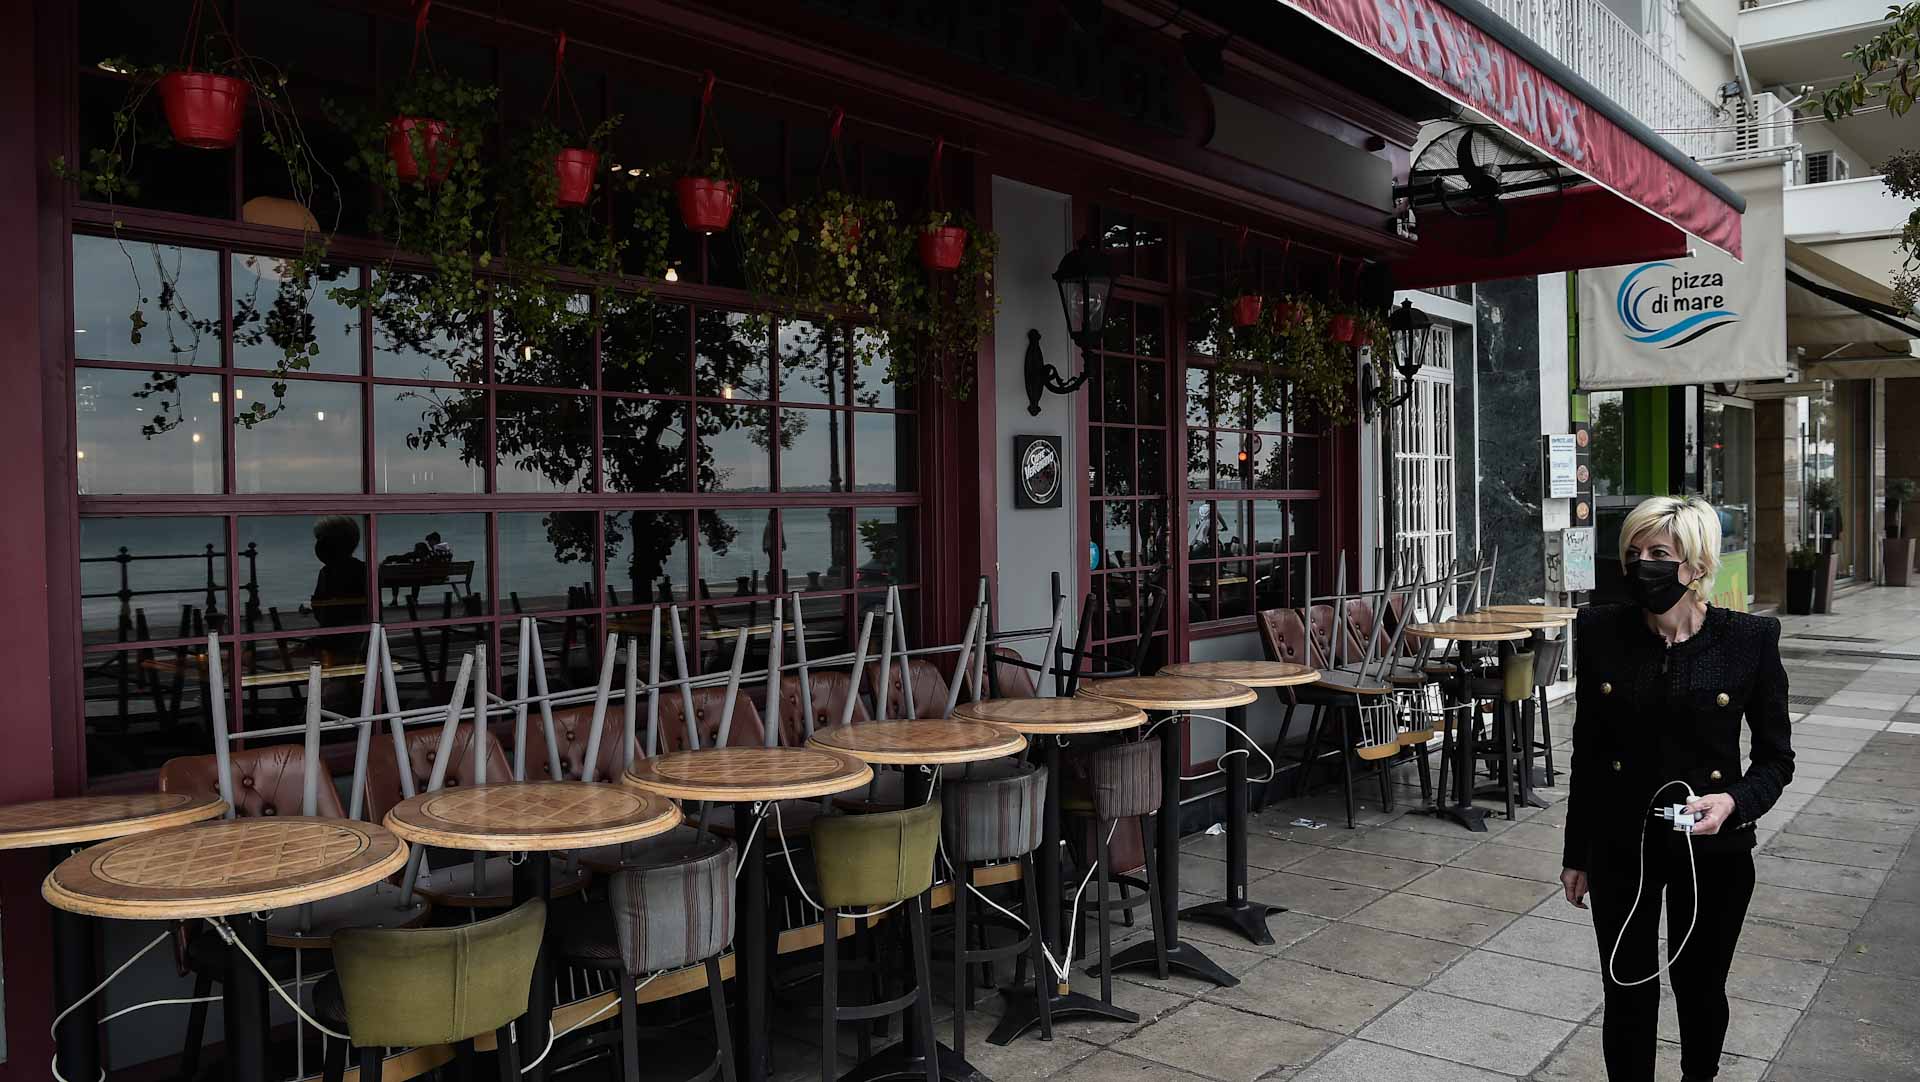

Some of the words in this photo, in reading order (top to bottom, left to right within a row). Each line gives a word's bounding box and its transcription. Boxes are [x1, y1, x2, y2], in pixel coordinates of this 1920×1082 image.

[1672, 272, 1723, 297] pizza
[1651, 293, 1668, 314] di
[1673, 294, 1724, 312] mare
